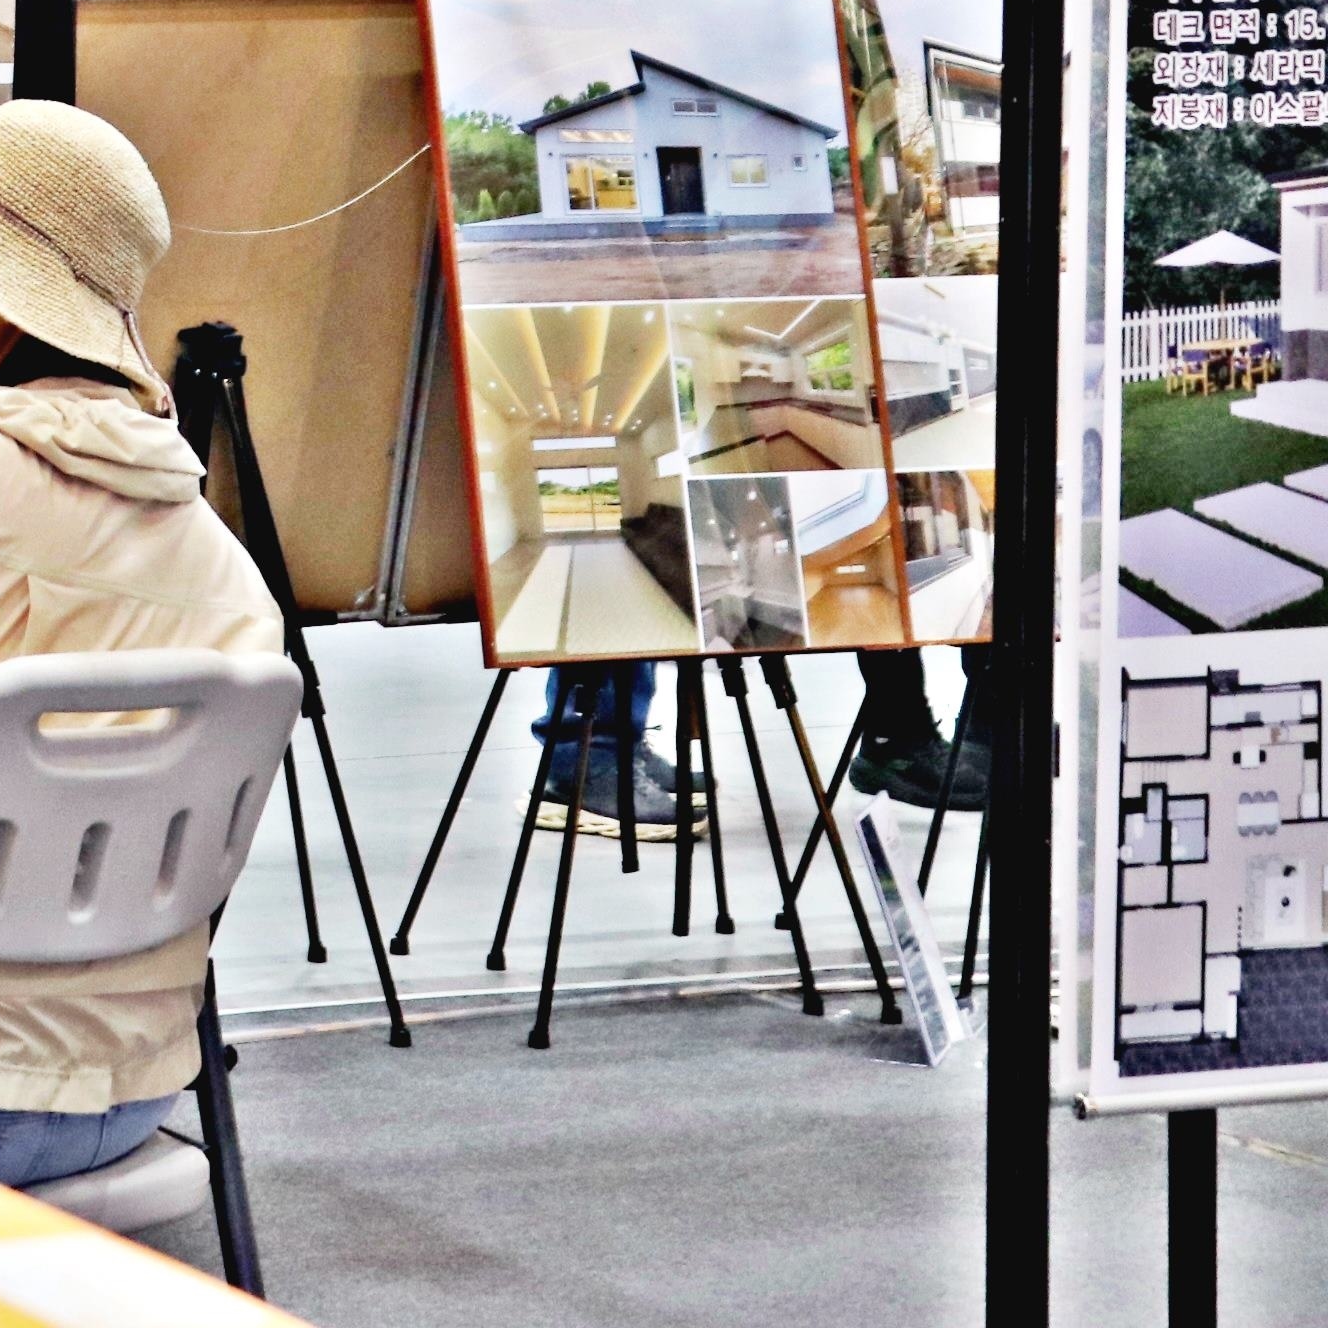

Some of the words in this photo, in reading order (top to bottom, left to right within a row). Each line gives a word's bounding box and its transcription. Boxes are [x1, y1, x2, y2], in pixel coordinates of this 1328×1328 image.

[1156, 12, 1202, 42] 데크
[1213, 12, 1256, 42] 면적
[1156, 54, 1225, 84] 외장재
[1252, 53, 1323, 82] 세라믹
[1155, 96, 1224, 126] 지붕재
[1253, 94, 1328, 123] 아스팔
